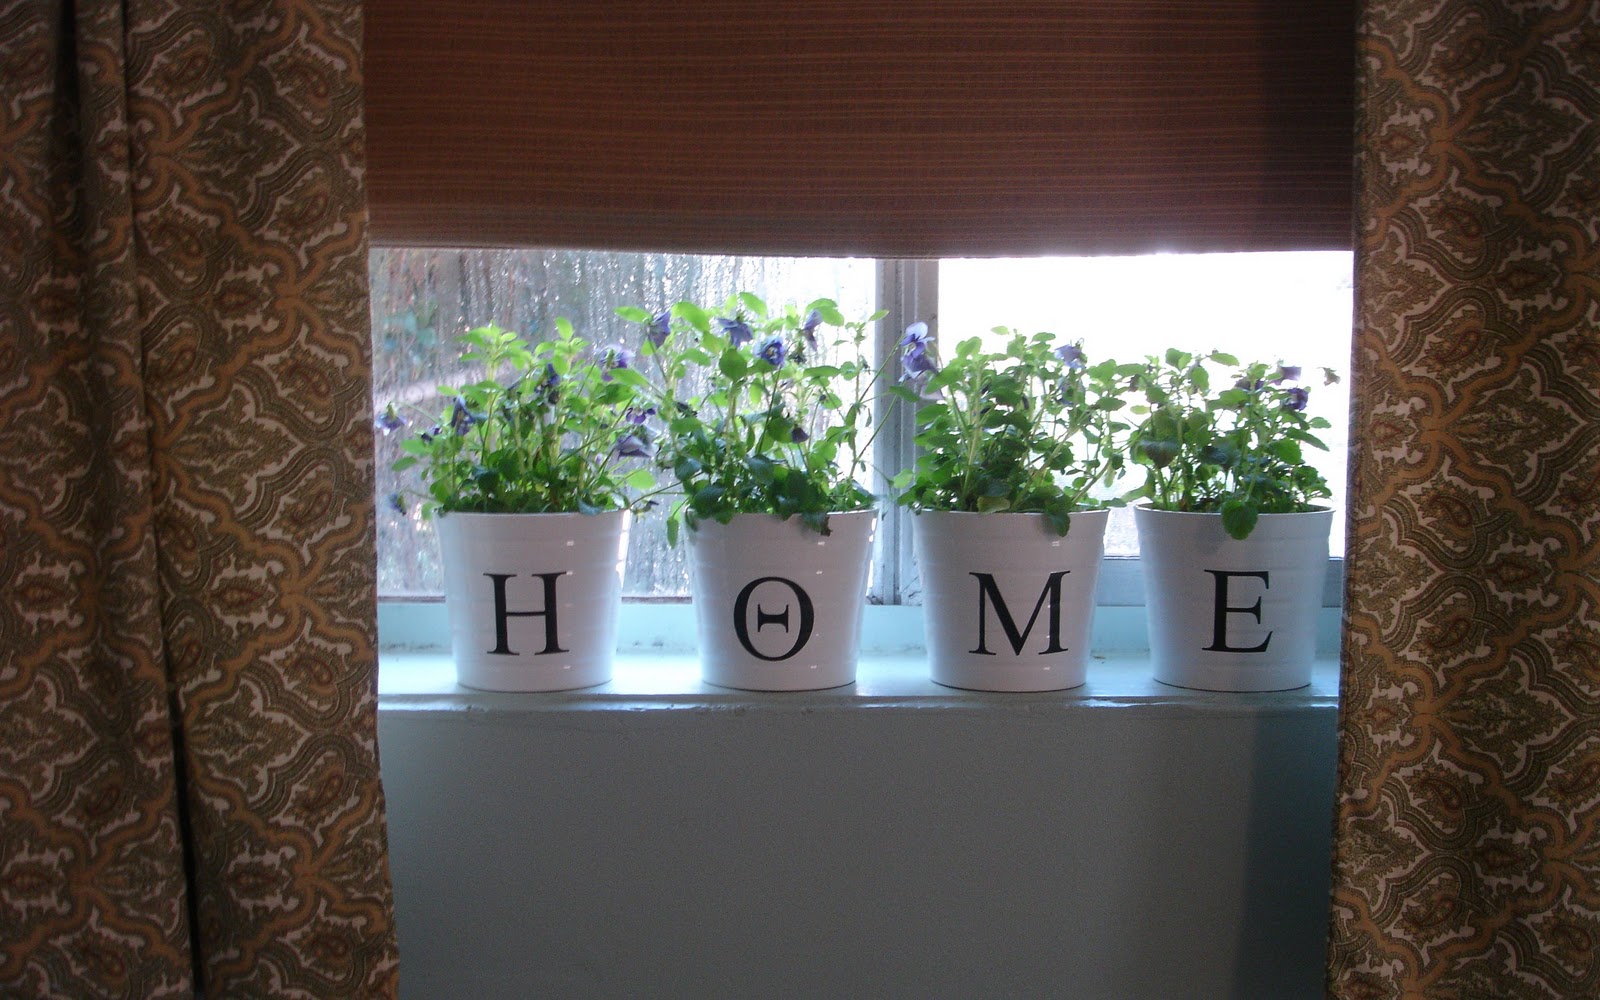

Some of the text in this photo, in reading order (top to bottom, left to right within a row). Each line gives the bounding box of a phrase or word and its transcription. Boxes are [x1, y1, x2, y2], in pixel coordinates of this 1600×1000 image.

[483, 571, 569, 656] H
[968, 571, 1070, 656] M
[1202, 569, 1273, 653] E
